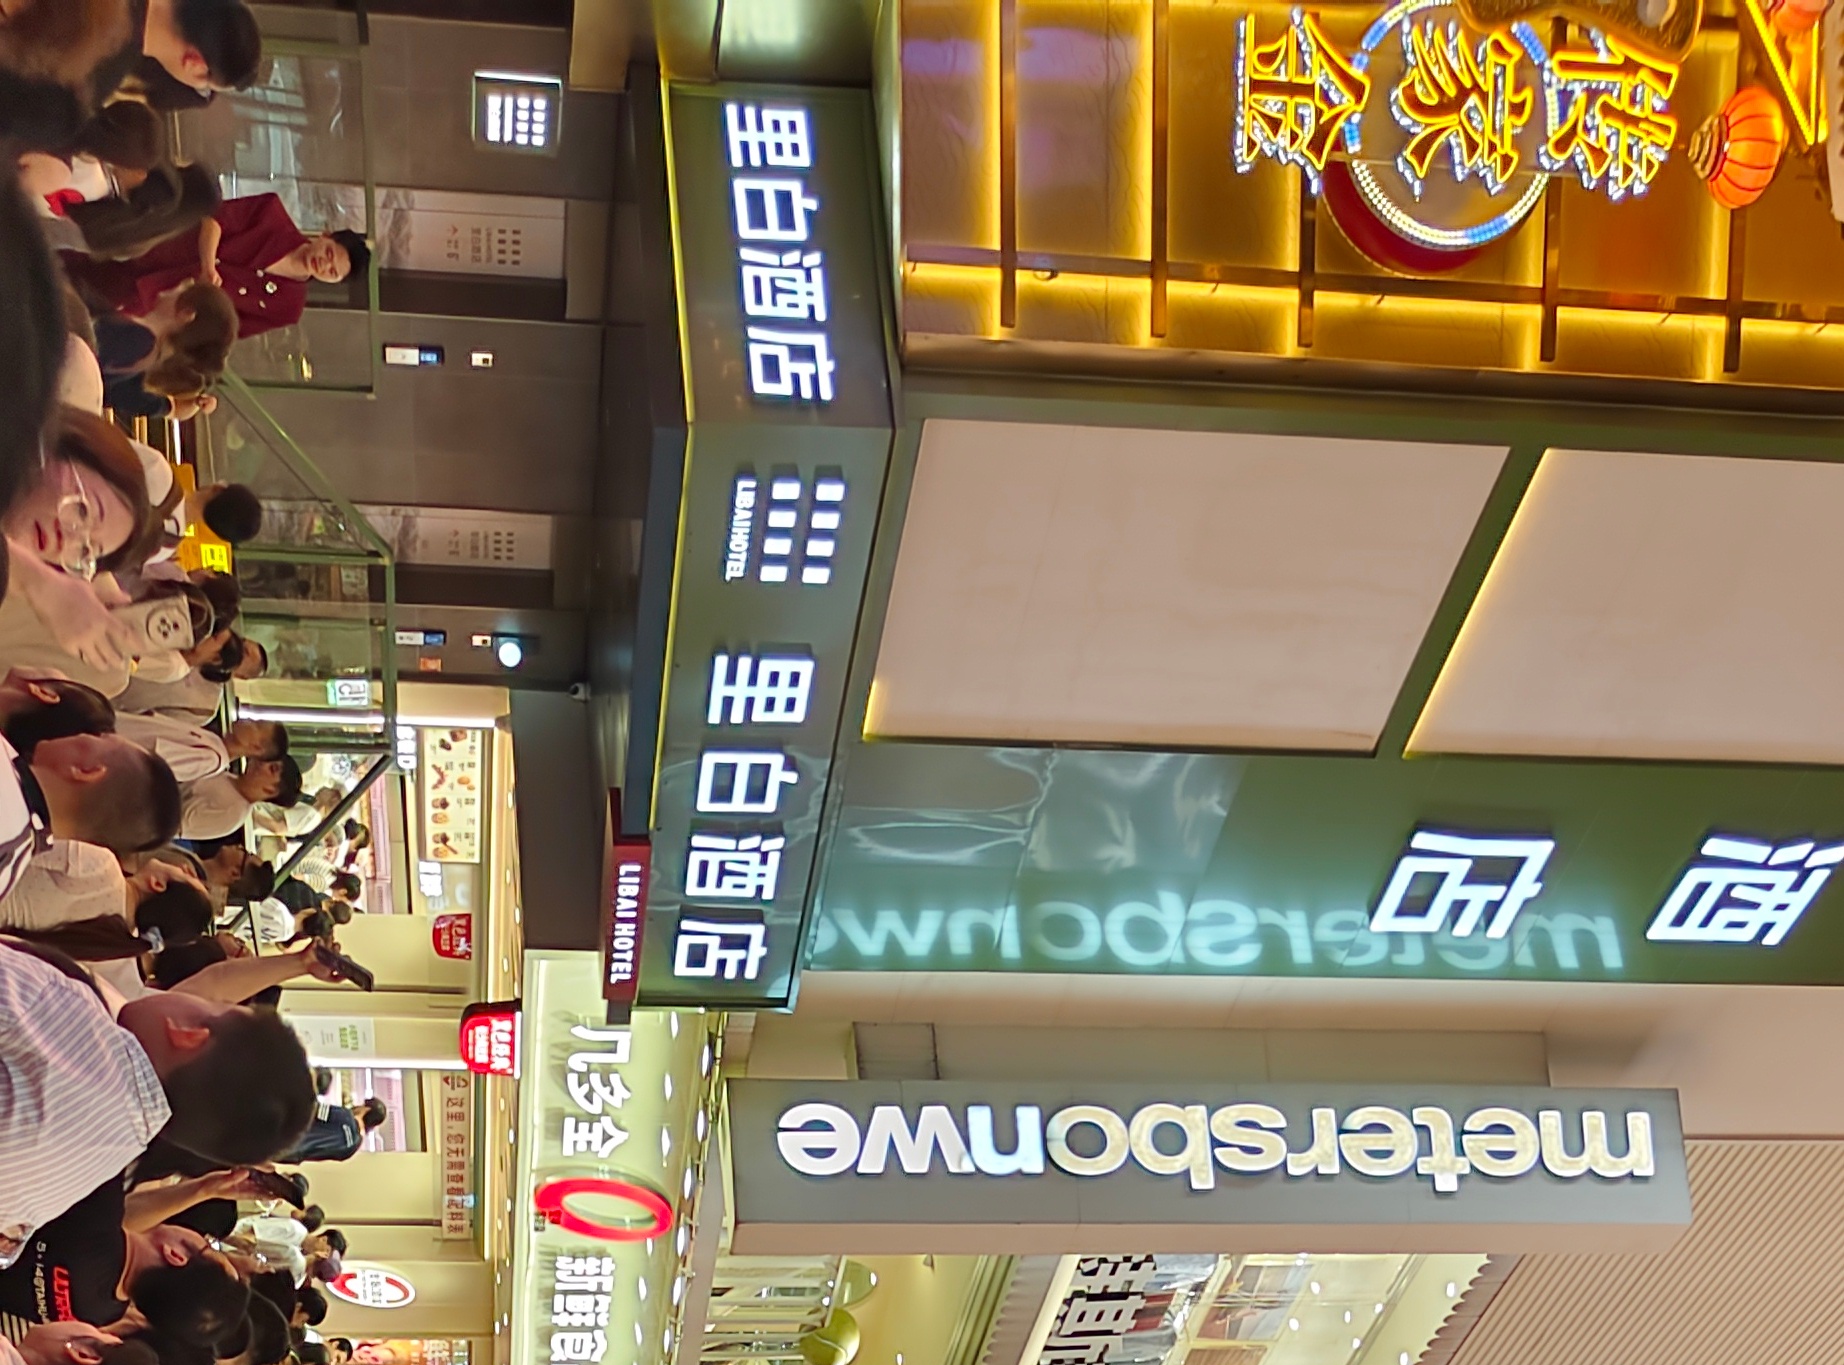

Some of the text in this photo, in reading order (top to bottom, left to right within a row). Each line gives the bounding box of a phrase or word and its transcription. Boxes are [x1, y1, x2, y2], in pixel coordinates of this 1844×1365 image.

[723, 102, 835, 401] 里白酒店
[673, 654, 816, 980] 里白酒店
[609, 864, 640, 984] LIBAI HOTEL
[1369, 830, 1844, 946] 酒店
[562, 1024, 631, 1158] 几多全
[776, 1102, 1656, 1192] metersbonwe
